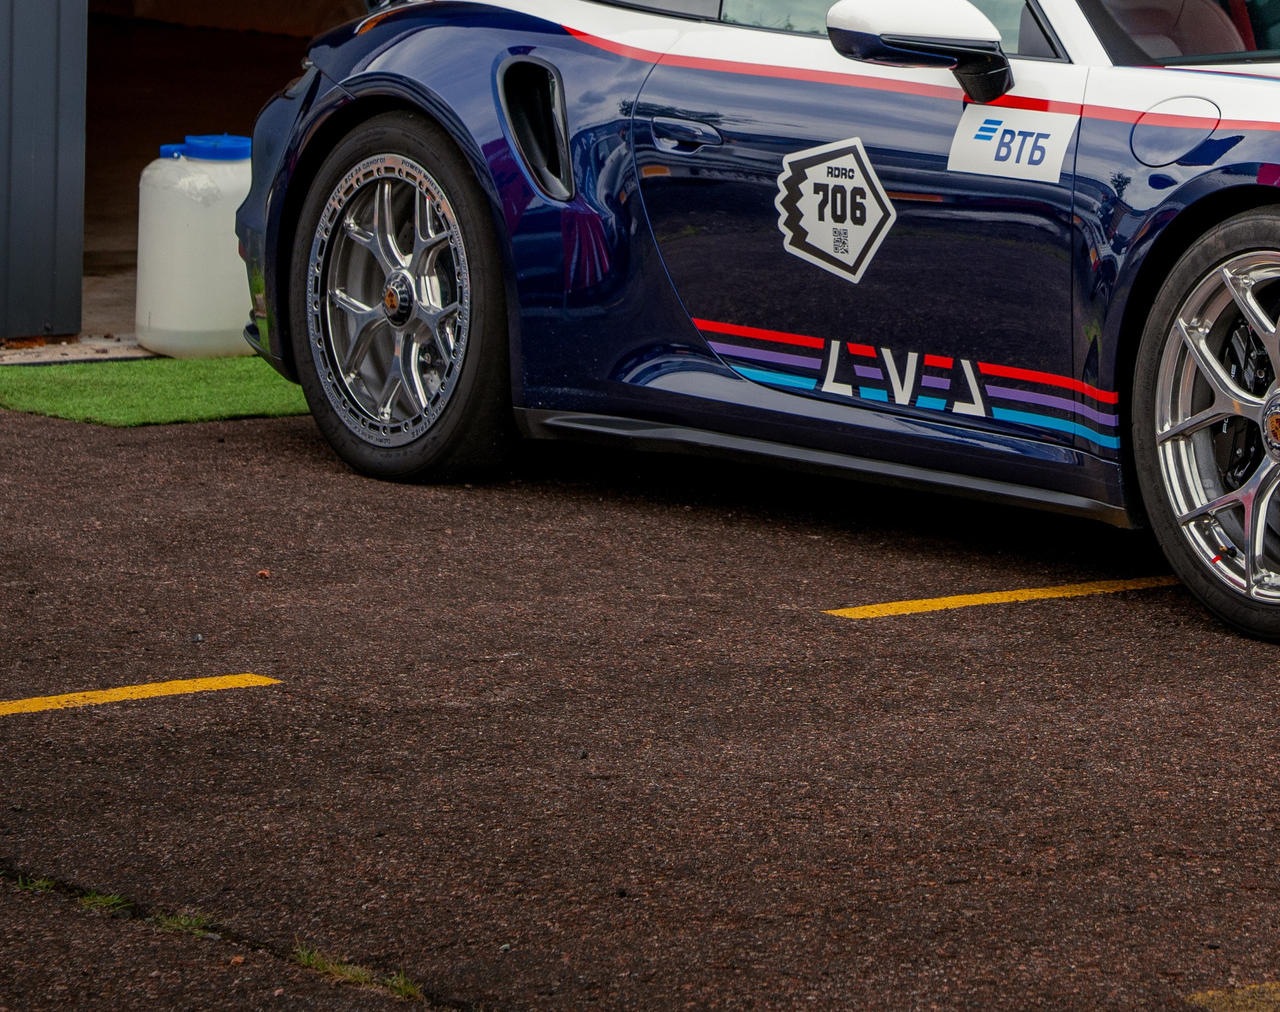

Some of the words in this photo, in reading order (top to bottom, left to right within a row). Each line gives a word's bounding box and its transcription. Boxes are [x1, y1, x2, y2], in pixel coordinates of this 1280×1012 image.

[994, 128, 1052, 166] ВТБ
[826, 165, 855, 180] RDRC
[812, 182, 867, 227] 706
